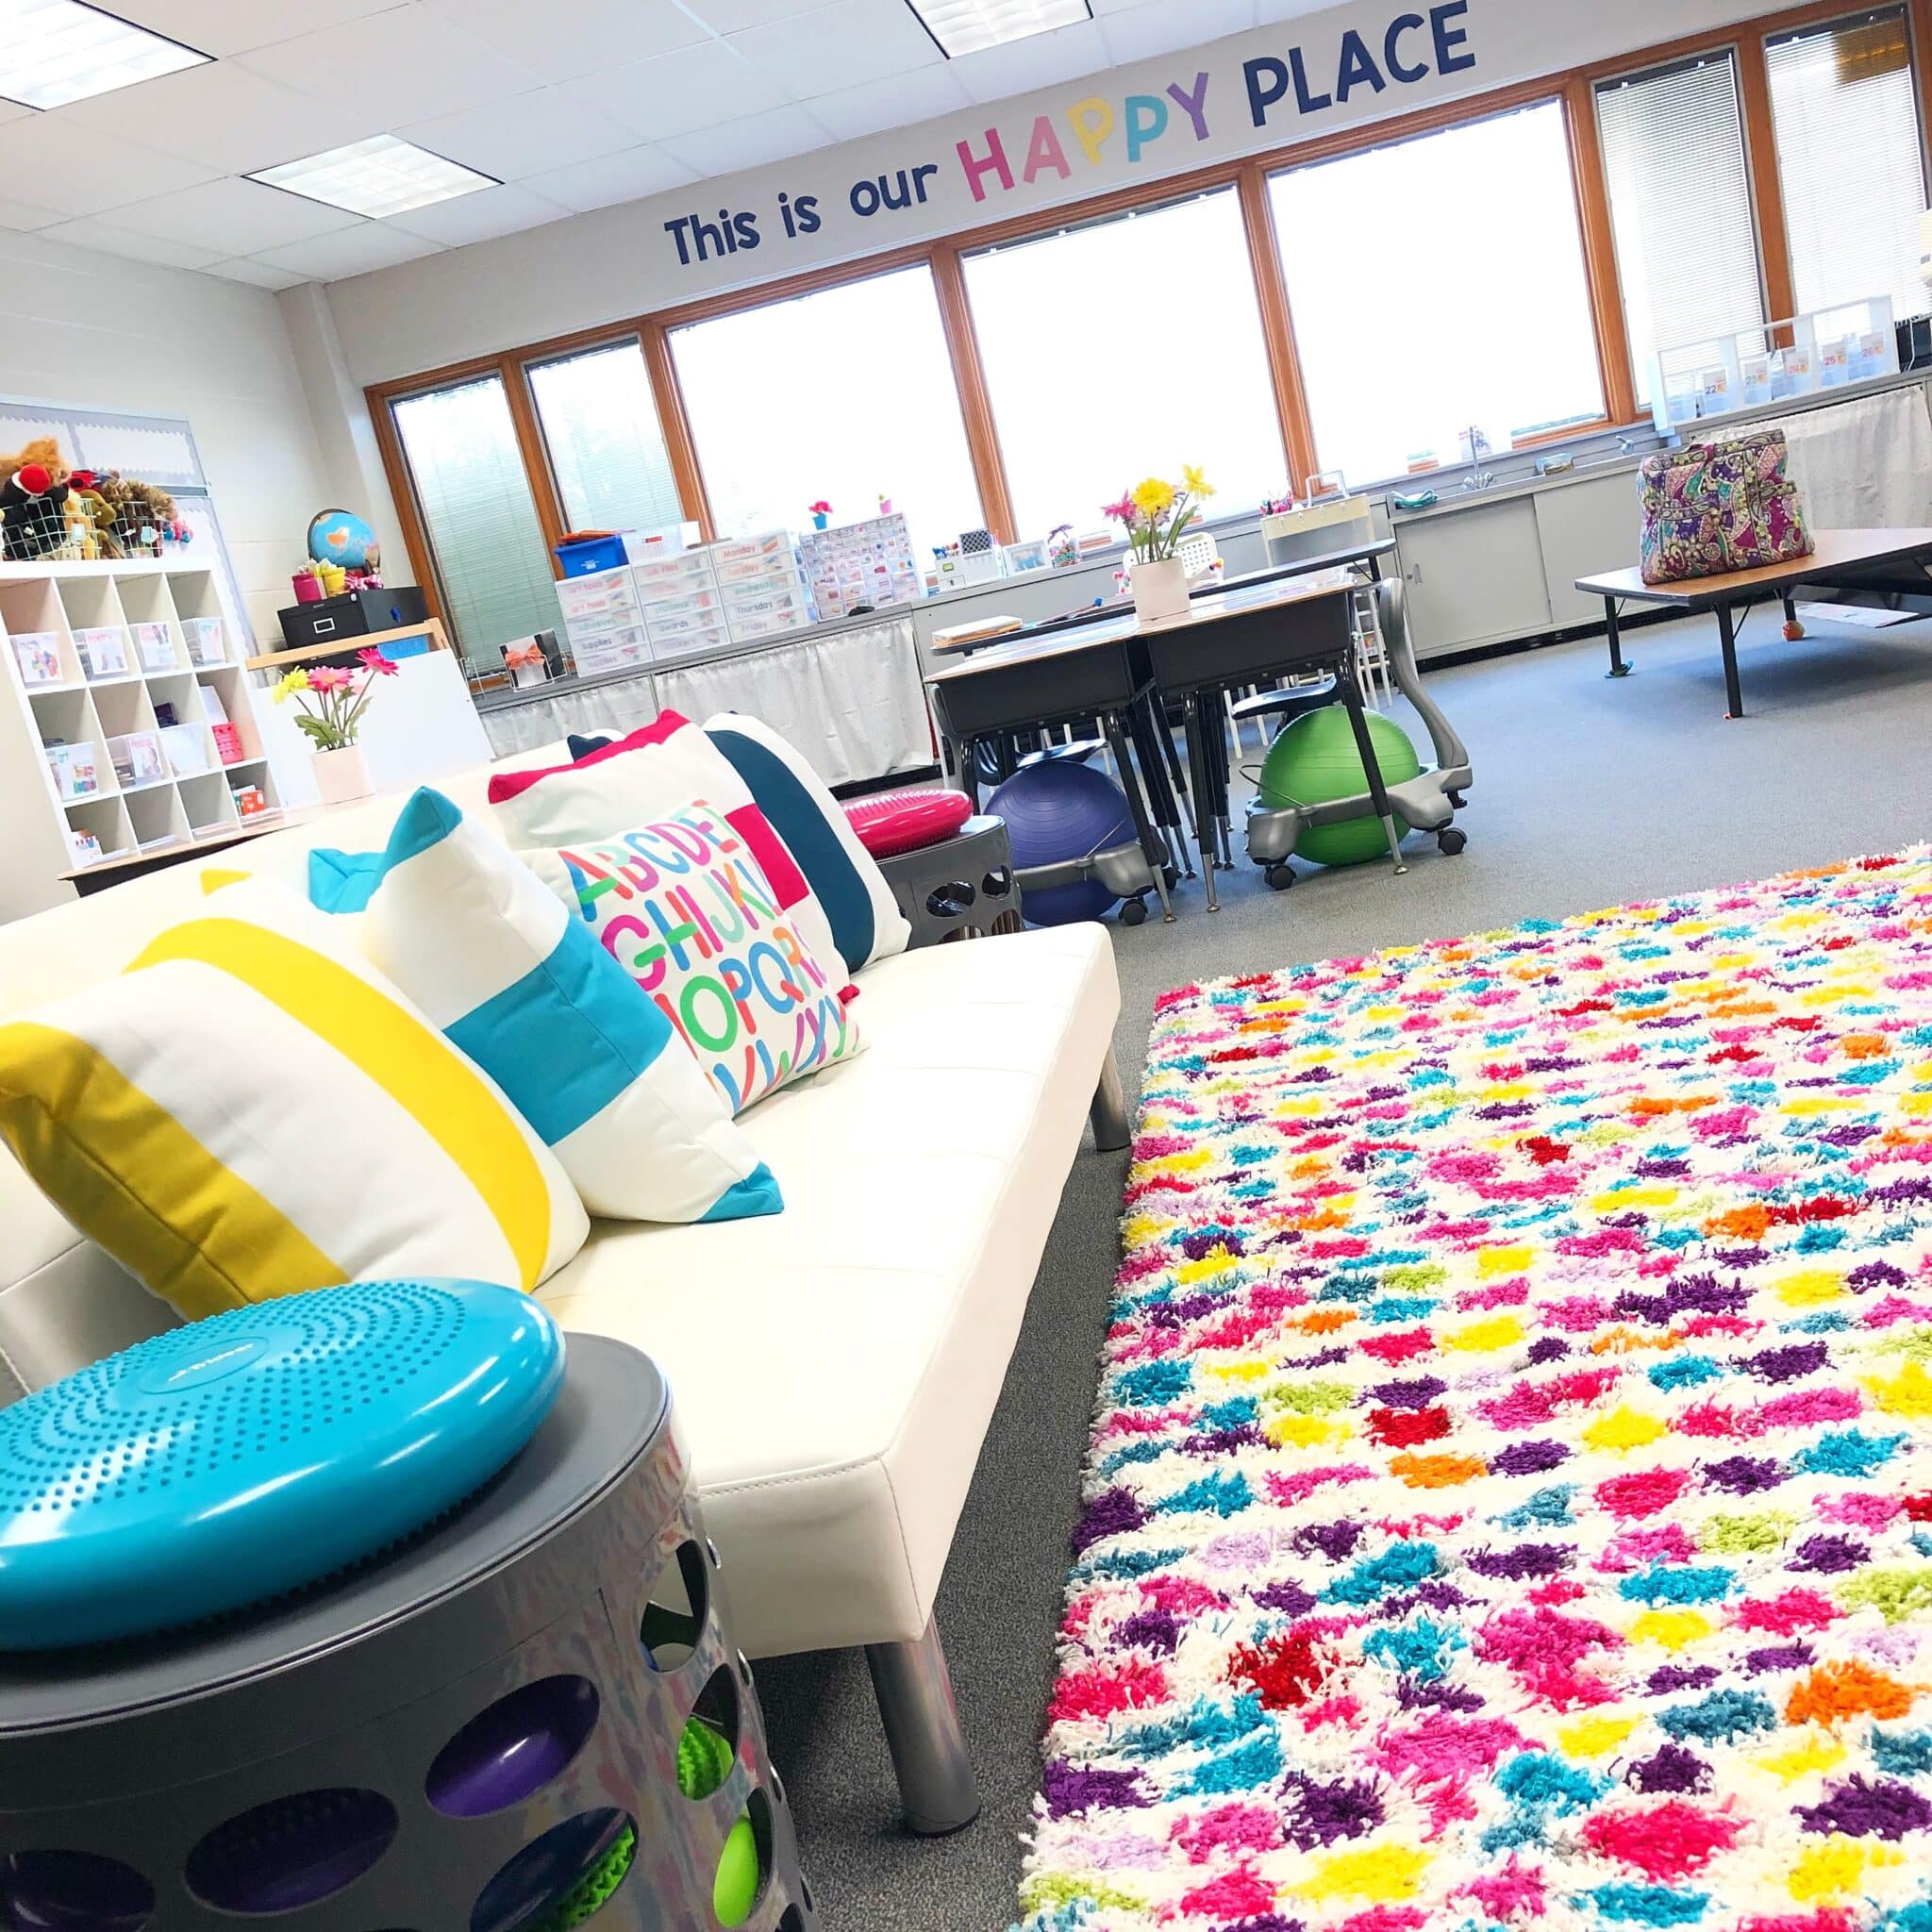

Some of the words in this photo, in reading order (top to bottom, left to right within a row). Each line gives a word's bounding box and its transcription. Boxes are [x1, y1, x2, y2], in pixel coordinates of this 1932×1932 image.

[664, 208, 760, 265] This
[778, 192, 821, 238] is
[850, 163, 938, 216] our
[956, 72, 1209, 203] HAPPY
[1243, 0, 1476, 127] PLACE
[1824, 357, 1836, 366] 25
[1706, 385, 1717, 394] 22
[724, 545, 756, 558] Monday
[737, 601, 773, 614] Thursday
